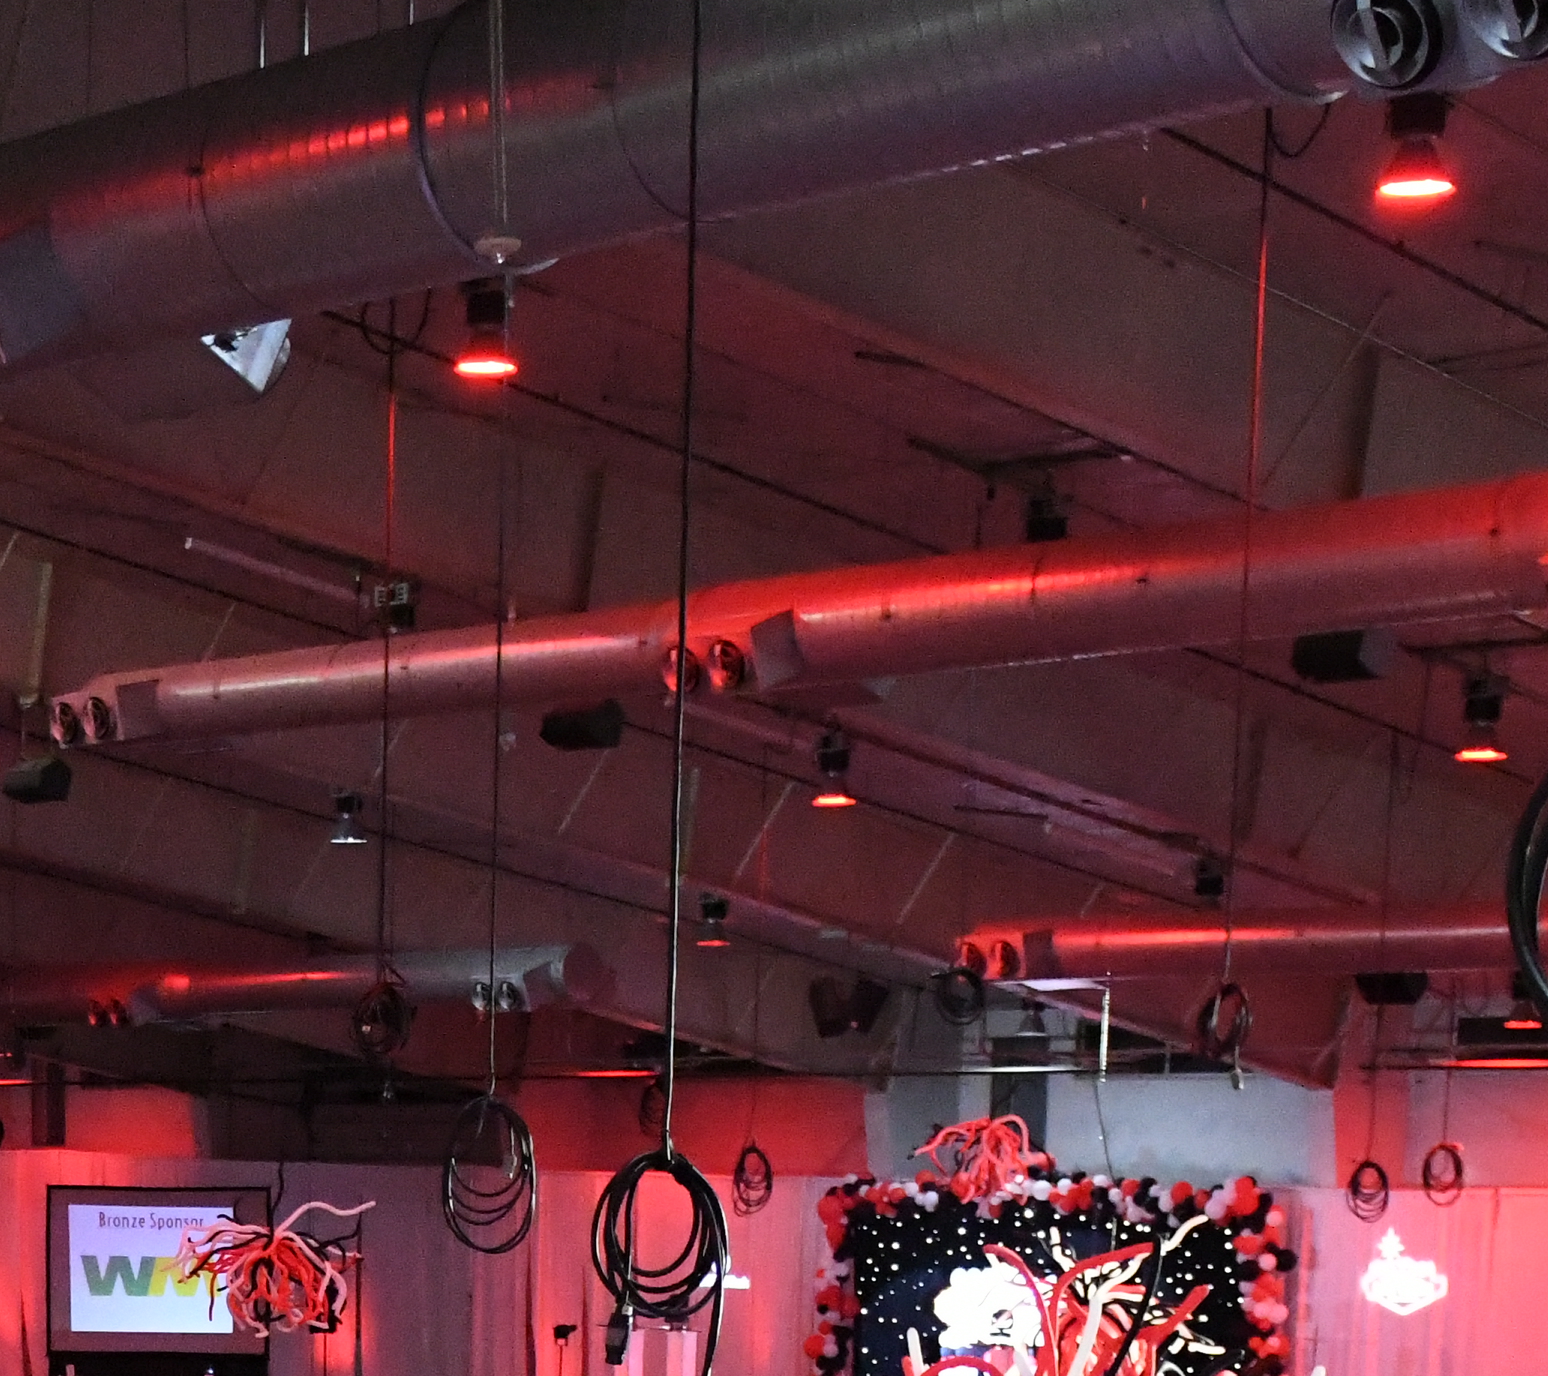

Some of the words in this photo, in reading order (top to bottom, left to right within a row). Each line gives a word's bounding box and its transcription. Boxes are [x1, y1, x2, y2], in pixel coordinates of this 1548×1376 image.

[98, 1211, 146, 1228] Bronze
[149, 1212, 204, 1230] Sponsor
[80, 1254, 223, 1297] WM
